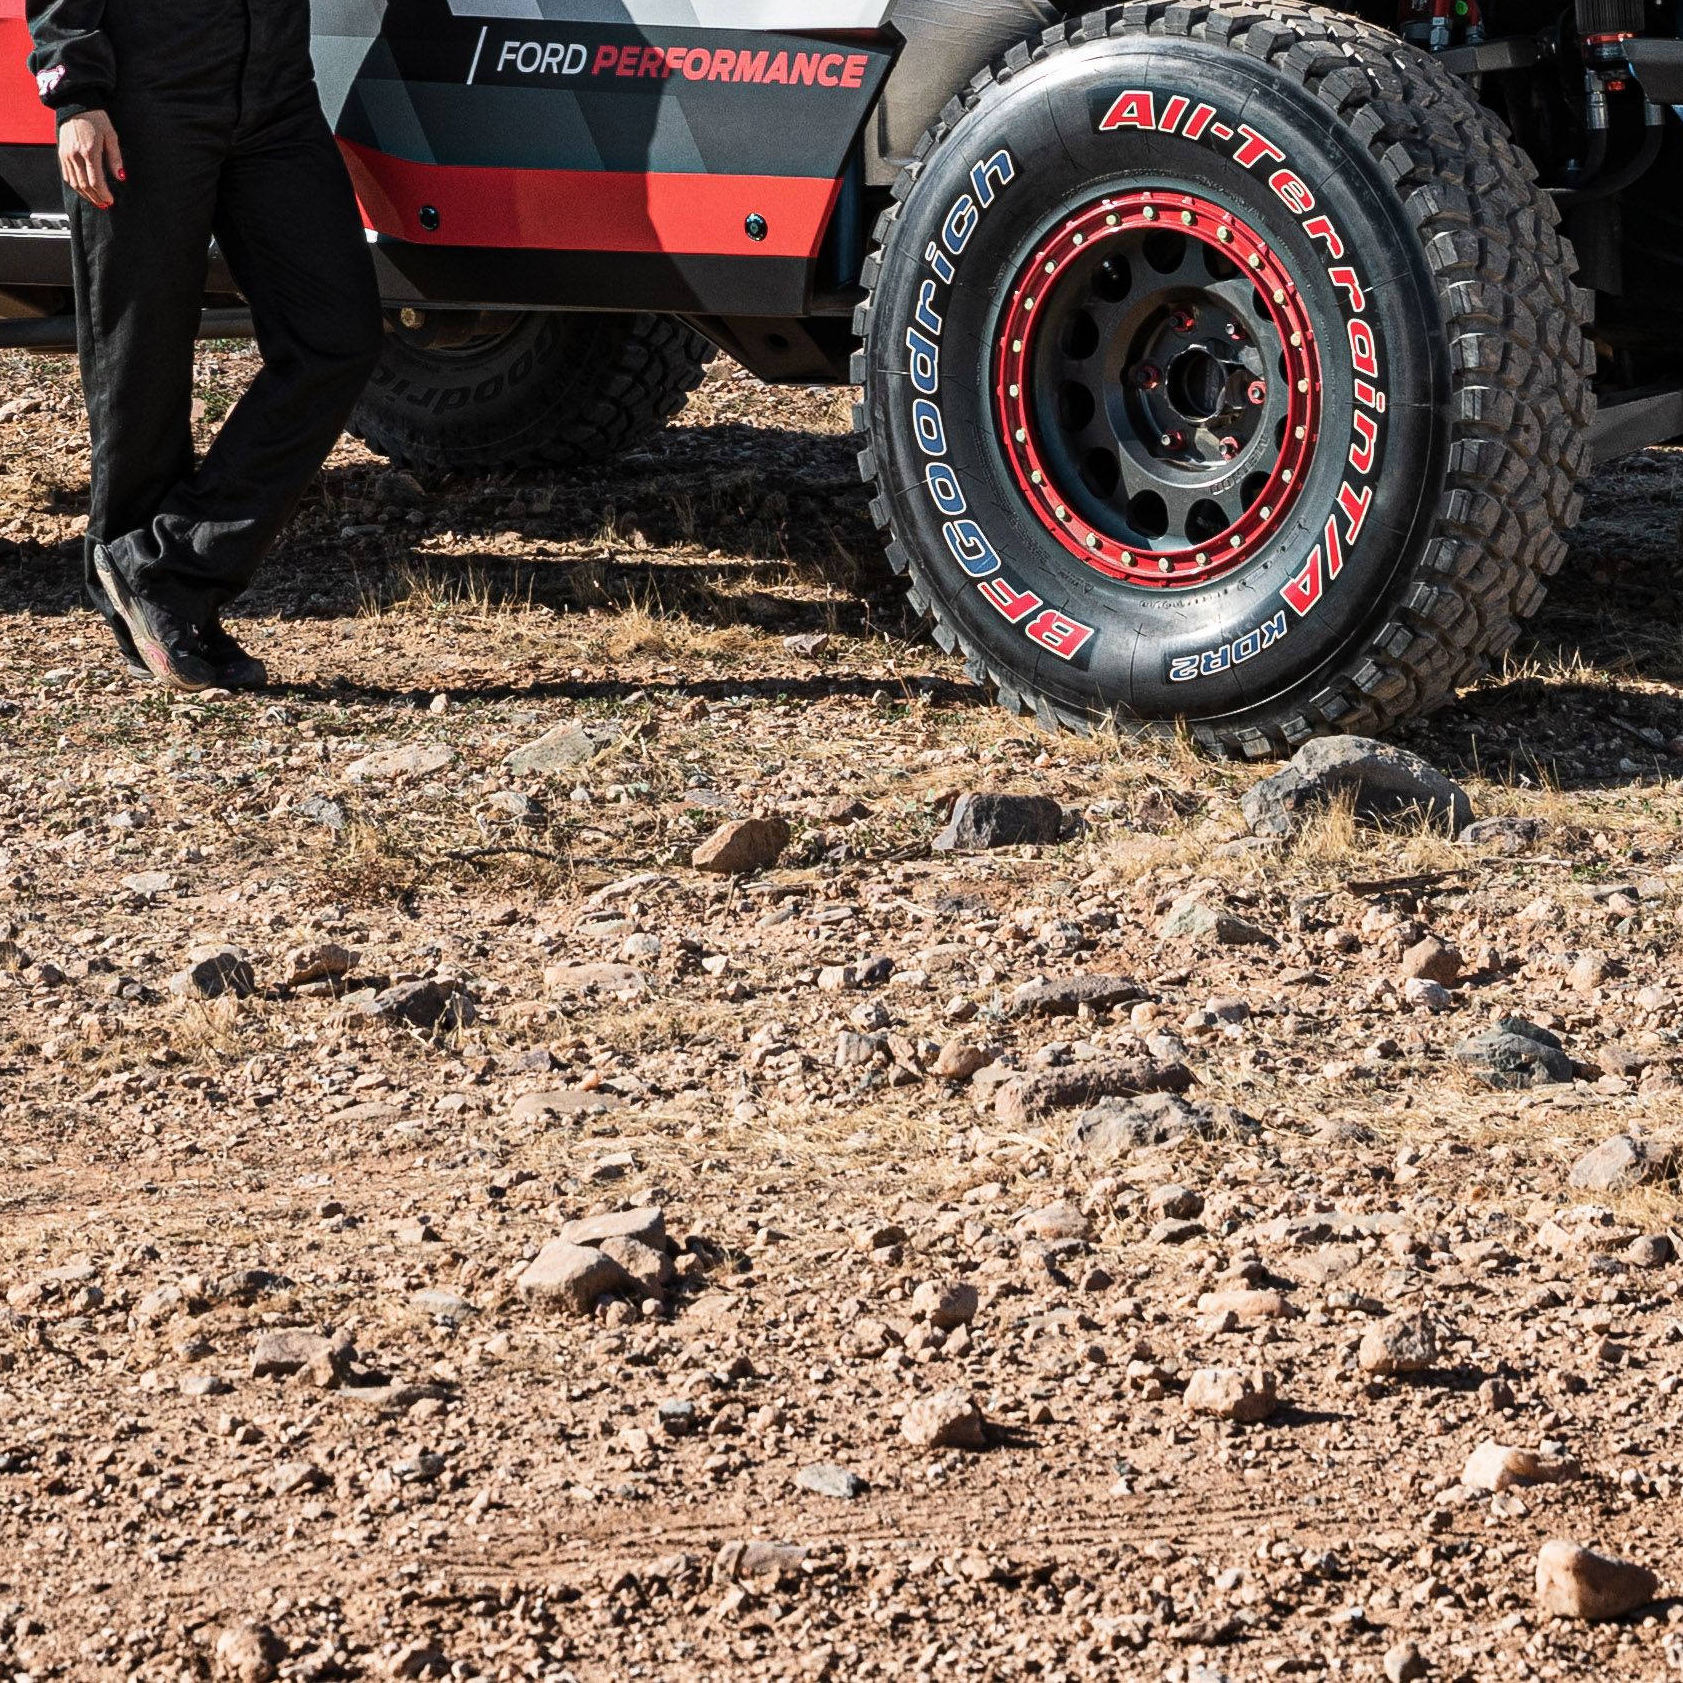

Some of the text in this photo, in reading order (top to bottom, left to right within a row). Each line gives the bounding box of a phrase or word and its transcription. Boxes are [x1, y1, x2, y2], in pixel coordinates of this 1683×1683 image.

[497, 41, 869, 89] FORD PERFORMANCE
[906, 148, 1095, 663] BFGoodrich
[1169, 610, 1289, 684] KDR2
